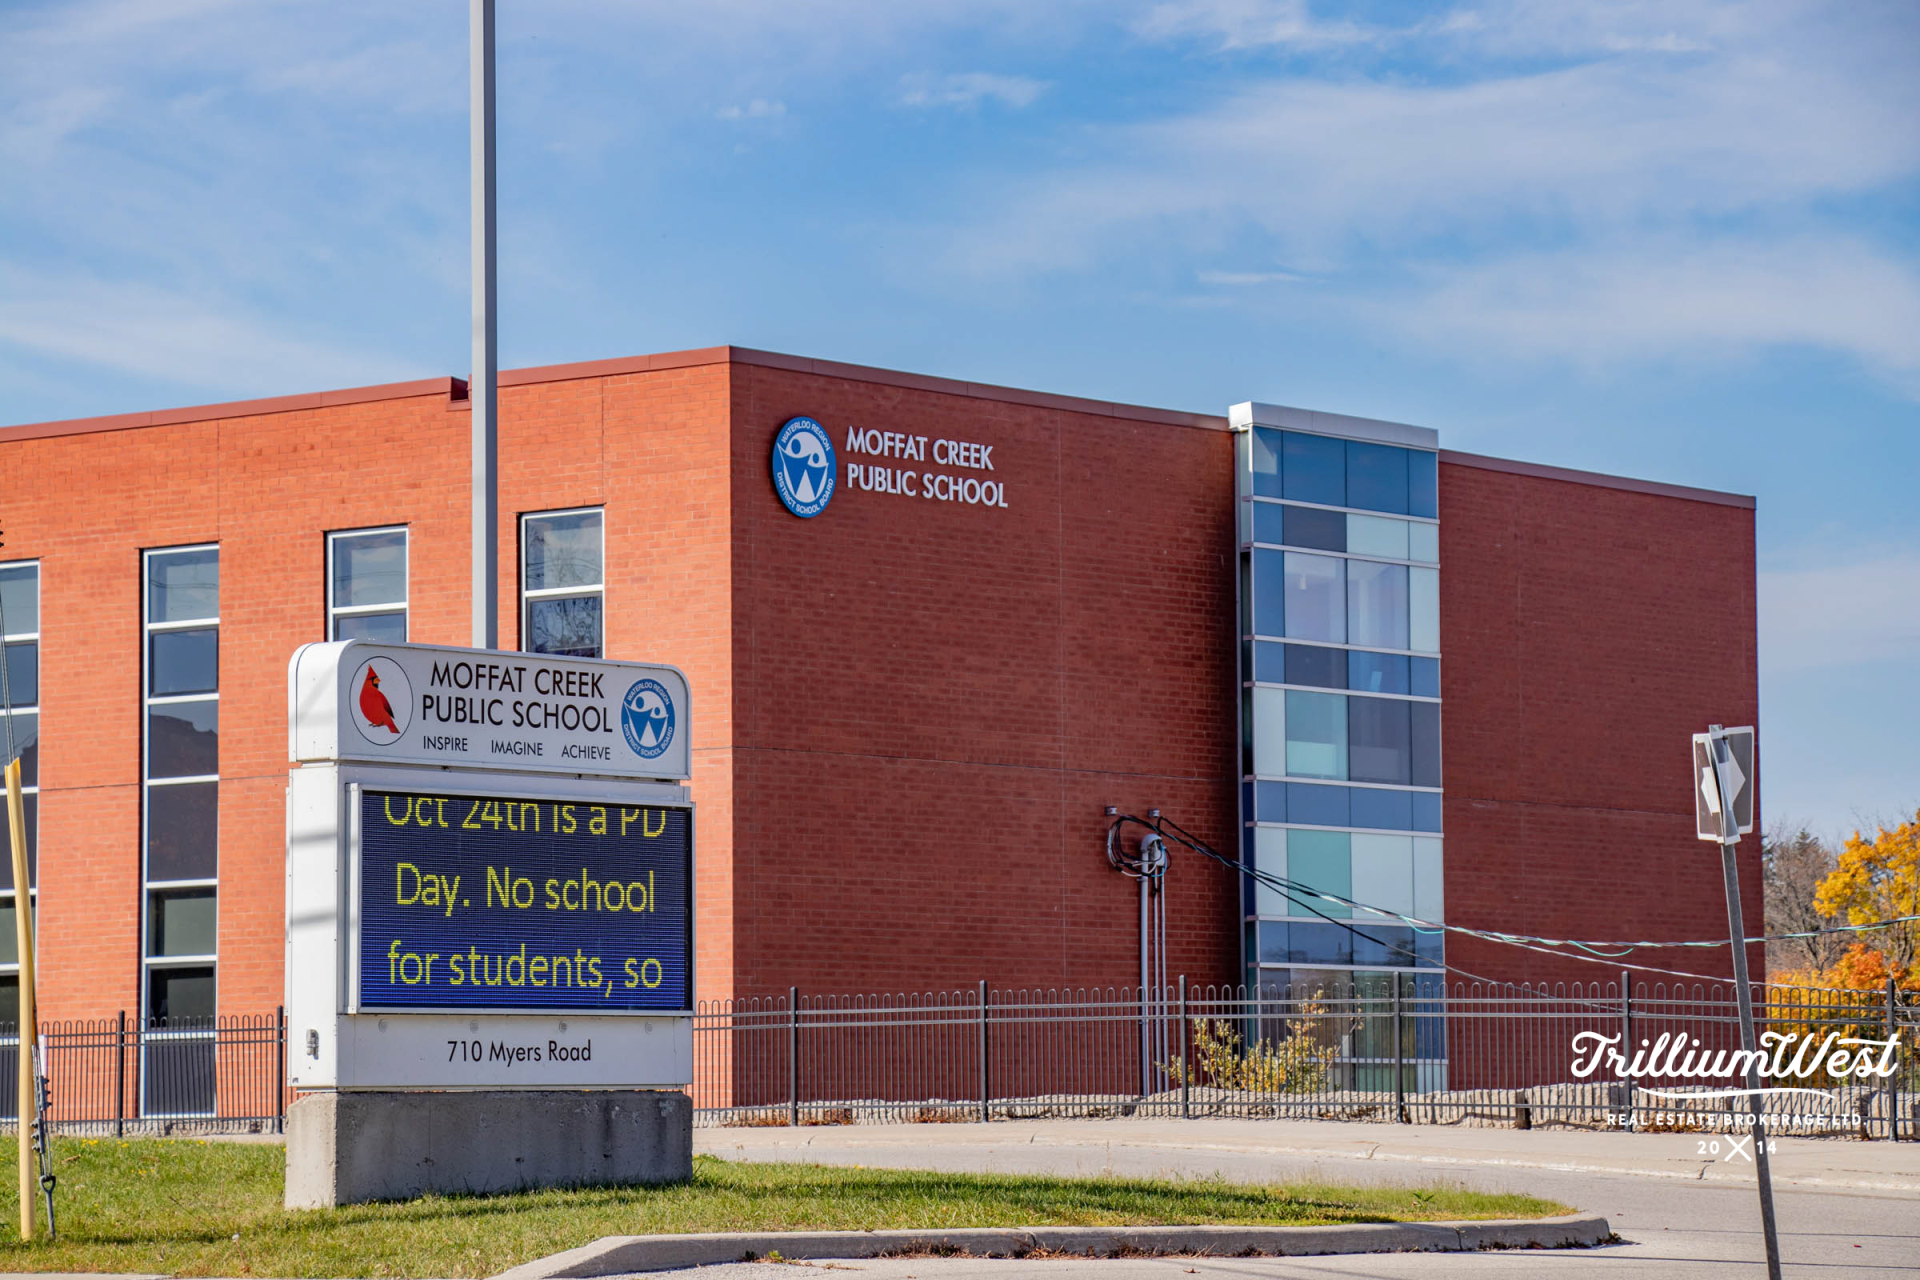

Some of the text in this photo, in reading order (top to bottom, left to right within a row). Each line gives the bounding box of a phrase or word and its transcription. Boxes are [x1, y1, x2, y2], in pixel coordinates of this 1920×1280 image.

[845, 425, 995, 471] MOFFAT CREEK
[777, 471, 834, 515] DISTRICT SCHOOL BOARD
[847, 462, 1009, 508] PUBLIC SCHOOL
[430, 660, 606, 699] MOFFAT CREEK
[422, 694, 613, 734] PUBLIC SCHOOL
[423, 735, 611, 760] INSPIRE IMAGINE ACHIEVE
[384, 796, 448, 827] Oct
[462, 800, 540, 831] 24th
[589, 806, 607, 835] a
[397, 863, 654, 916] Day. No school
[387, 940, 662, 998] for students, so
[448, 1039, 591, 1067] 710 Myers Road
